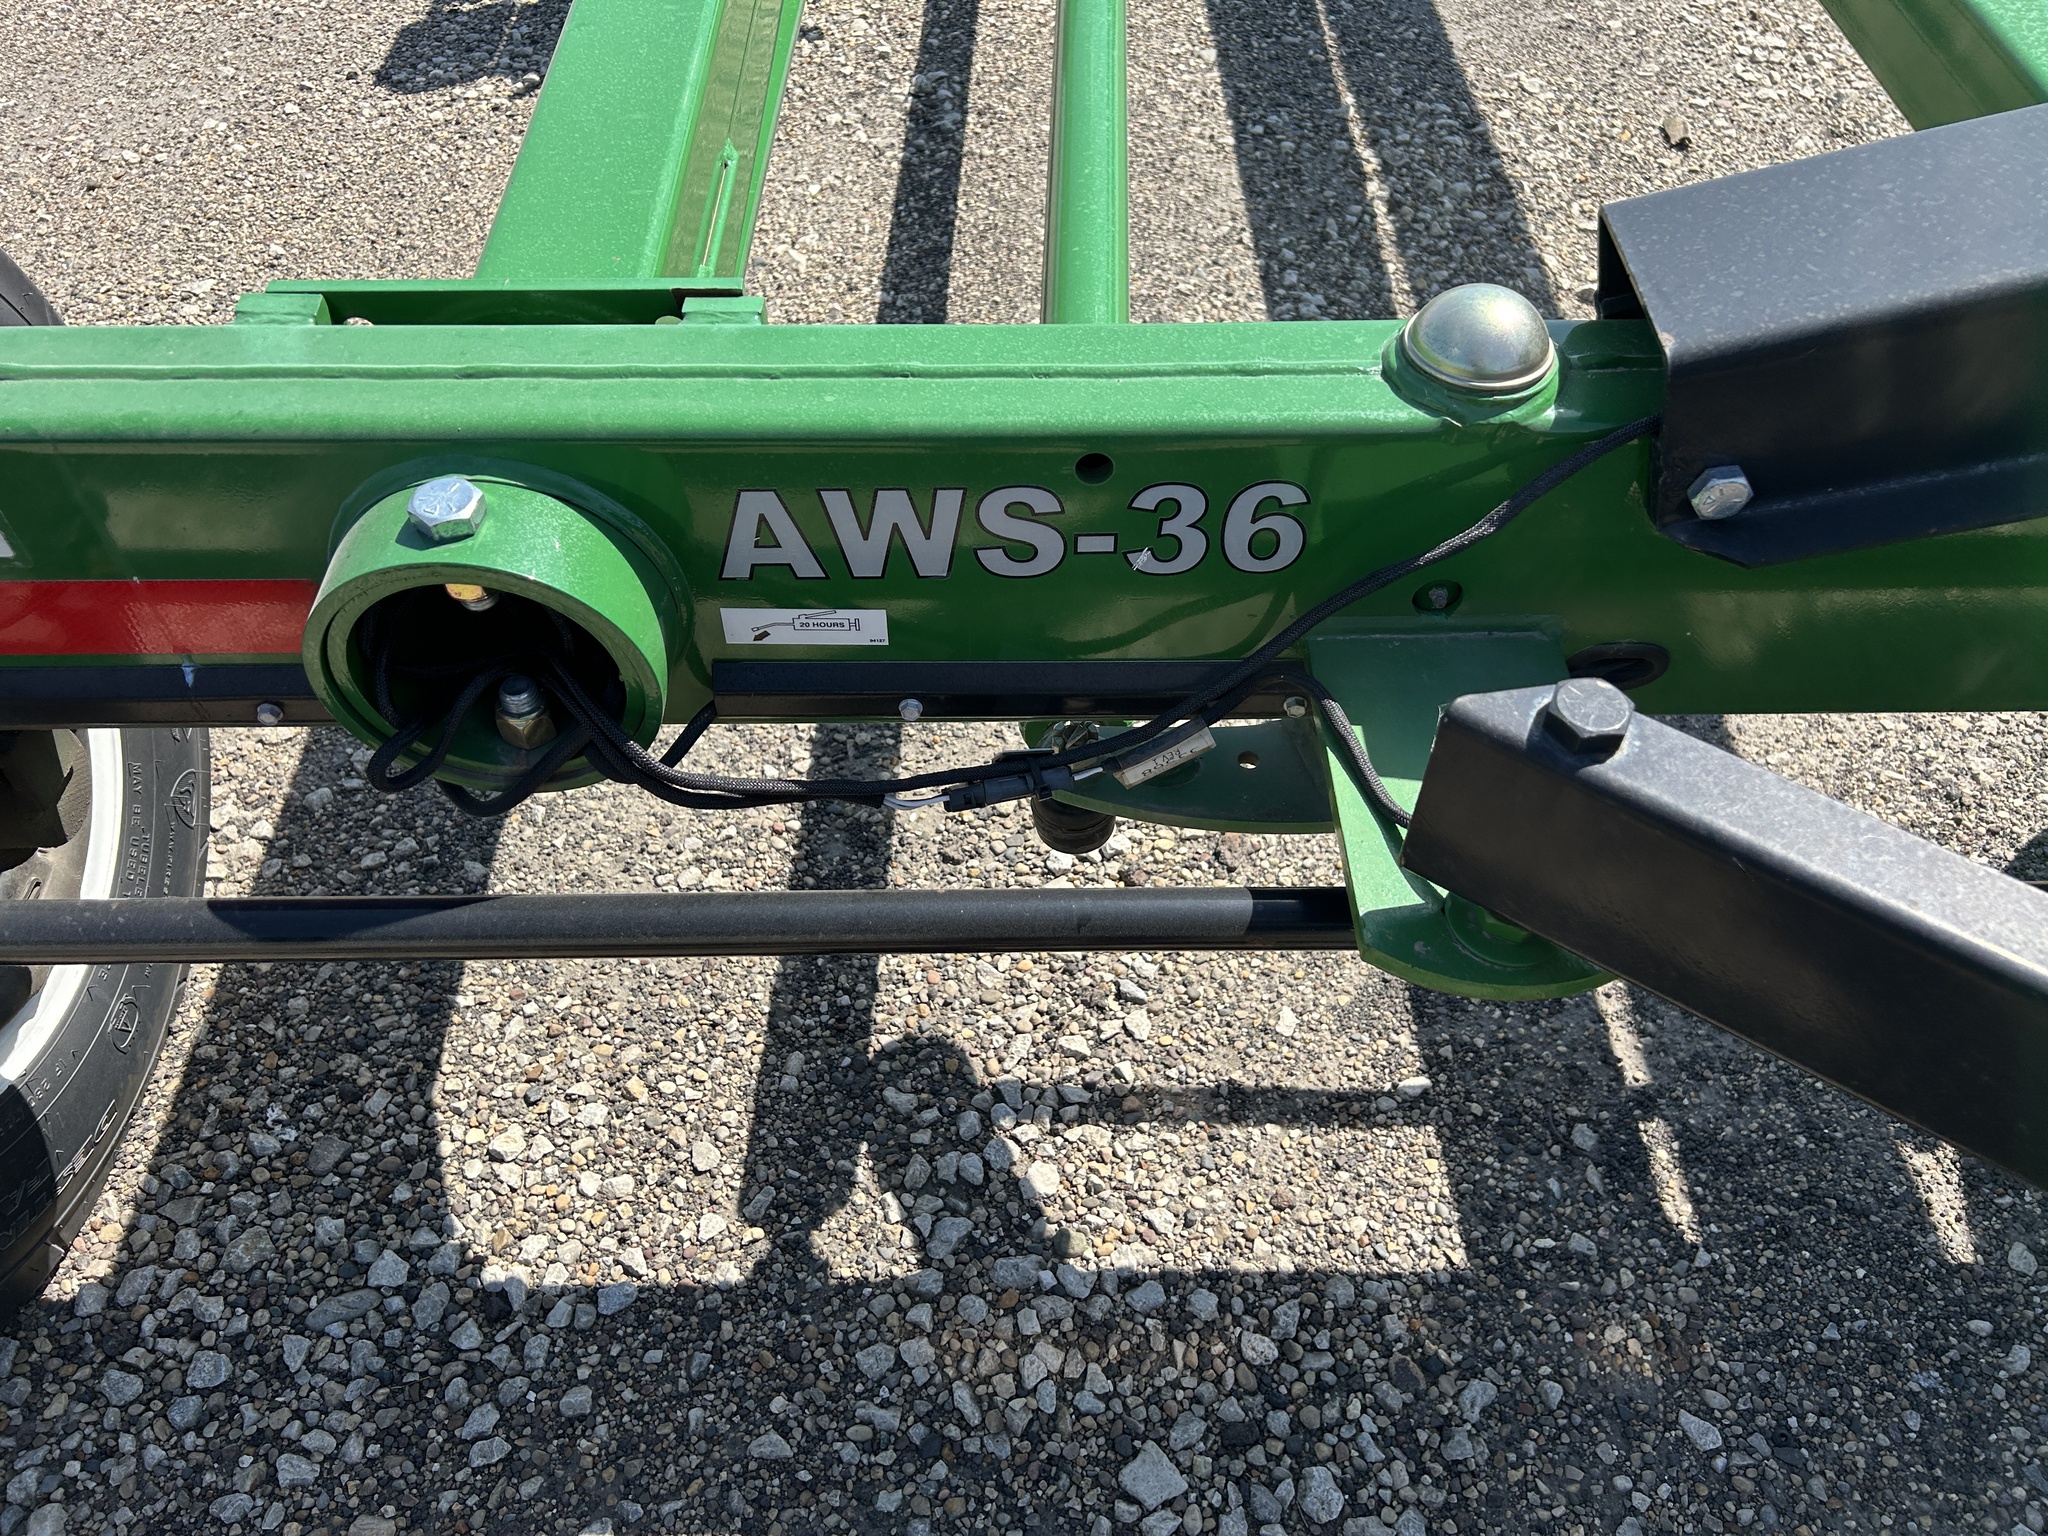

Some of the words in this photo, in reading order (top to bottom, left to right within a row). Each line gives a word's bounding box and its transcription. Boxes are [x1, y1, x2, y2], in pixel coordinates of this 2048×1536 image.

[719, 480, 1311, 581] AWS-36
[1162, 748, 1181, 761] REV
[132, 763, 143, 794] MAY
[131, 805, 141, 827] BE
[125, 837, 140, 882] USED
[134, 833, 150, 897] TUBELE
